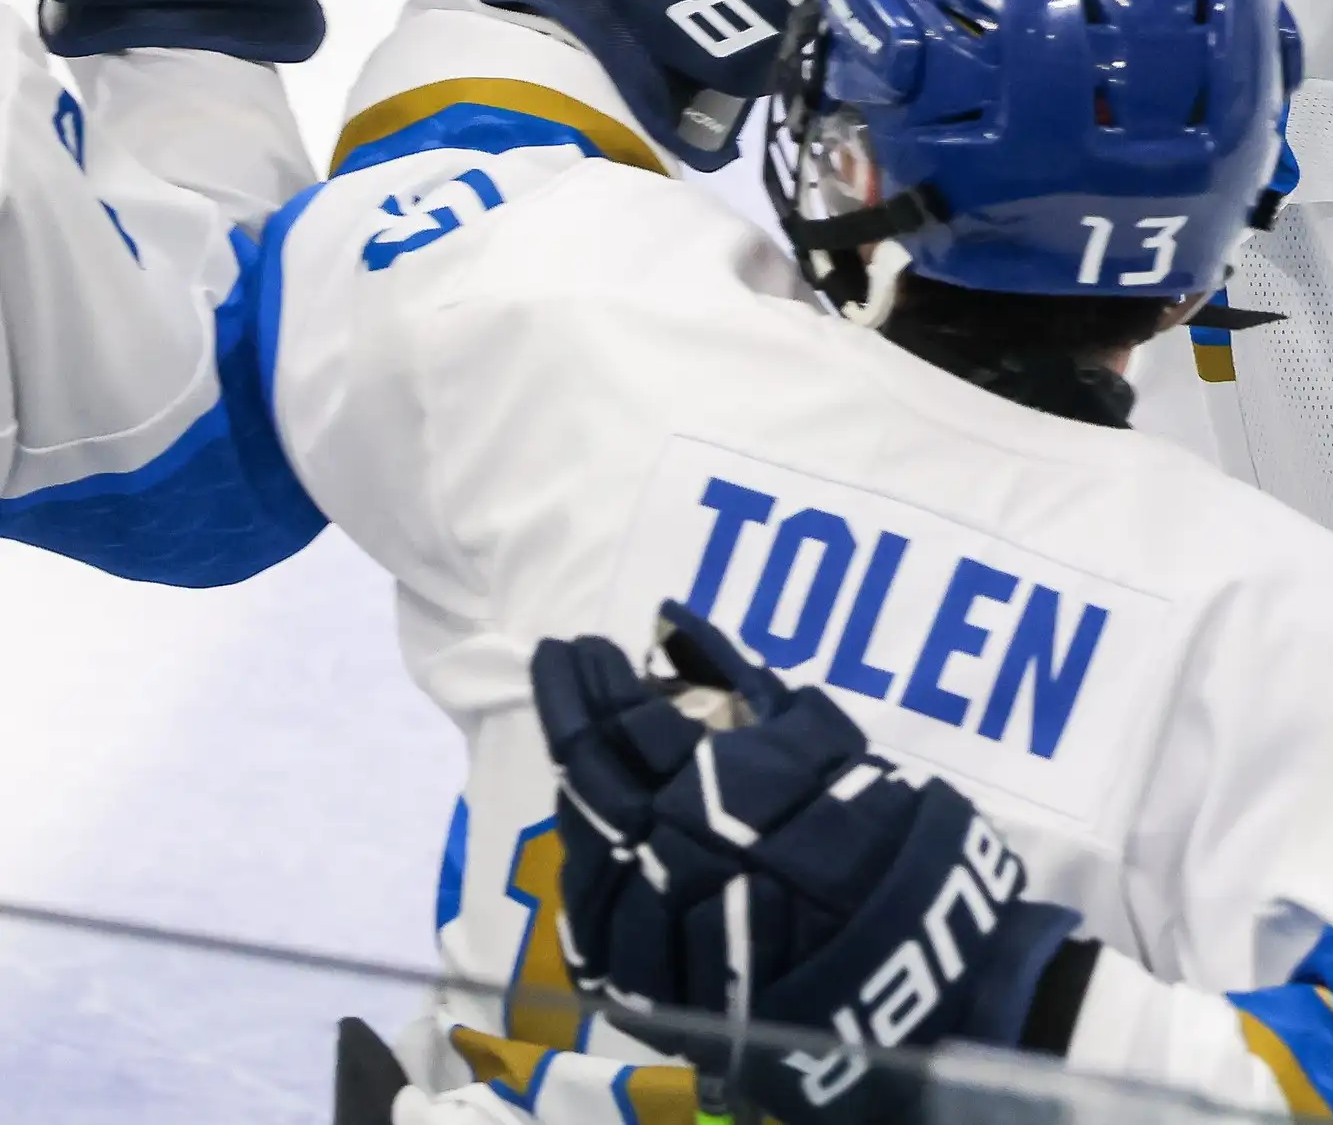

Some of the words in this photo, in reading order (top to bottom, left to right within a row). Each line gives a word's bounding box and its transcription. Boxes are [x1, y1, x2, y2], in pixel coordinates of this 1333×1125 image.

[1075, 214, 1190, 287] 13
[684, 476, 1111, 761] TOLEN
[780, 812, 1026, 1107] AUER
